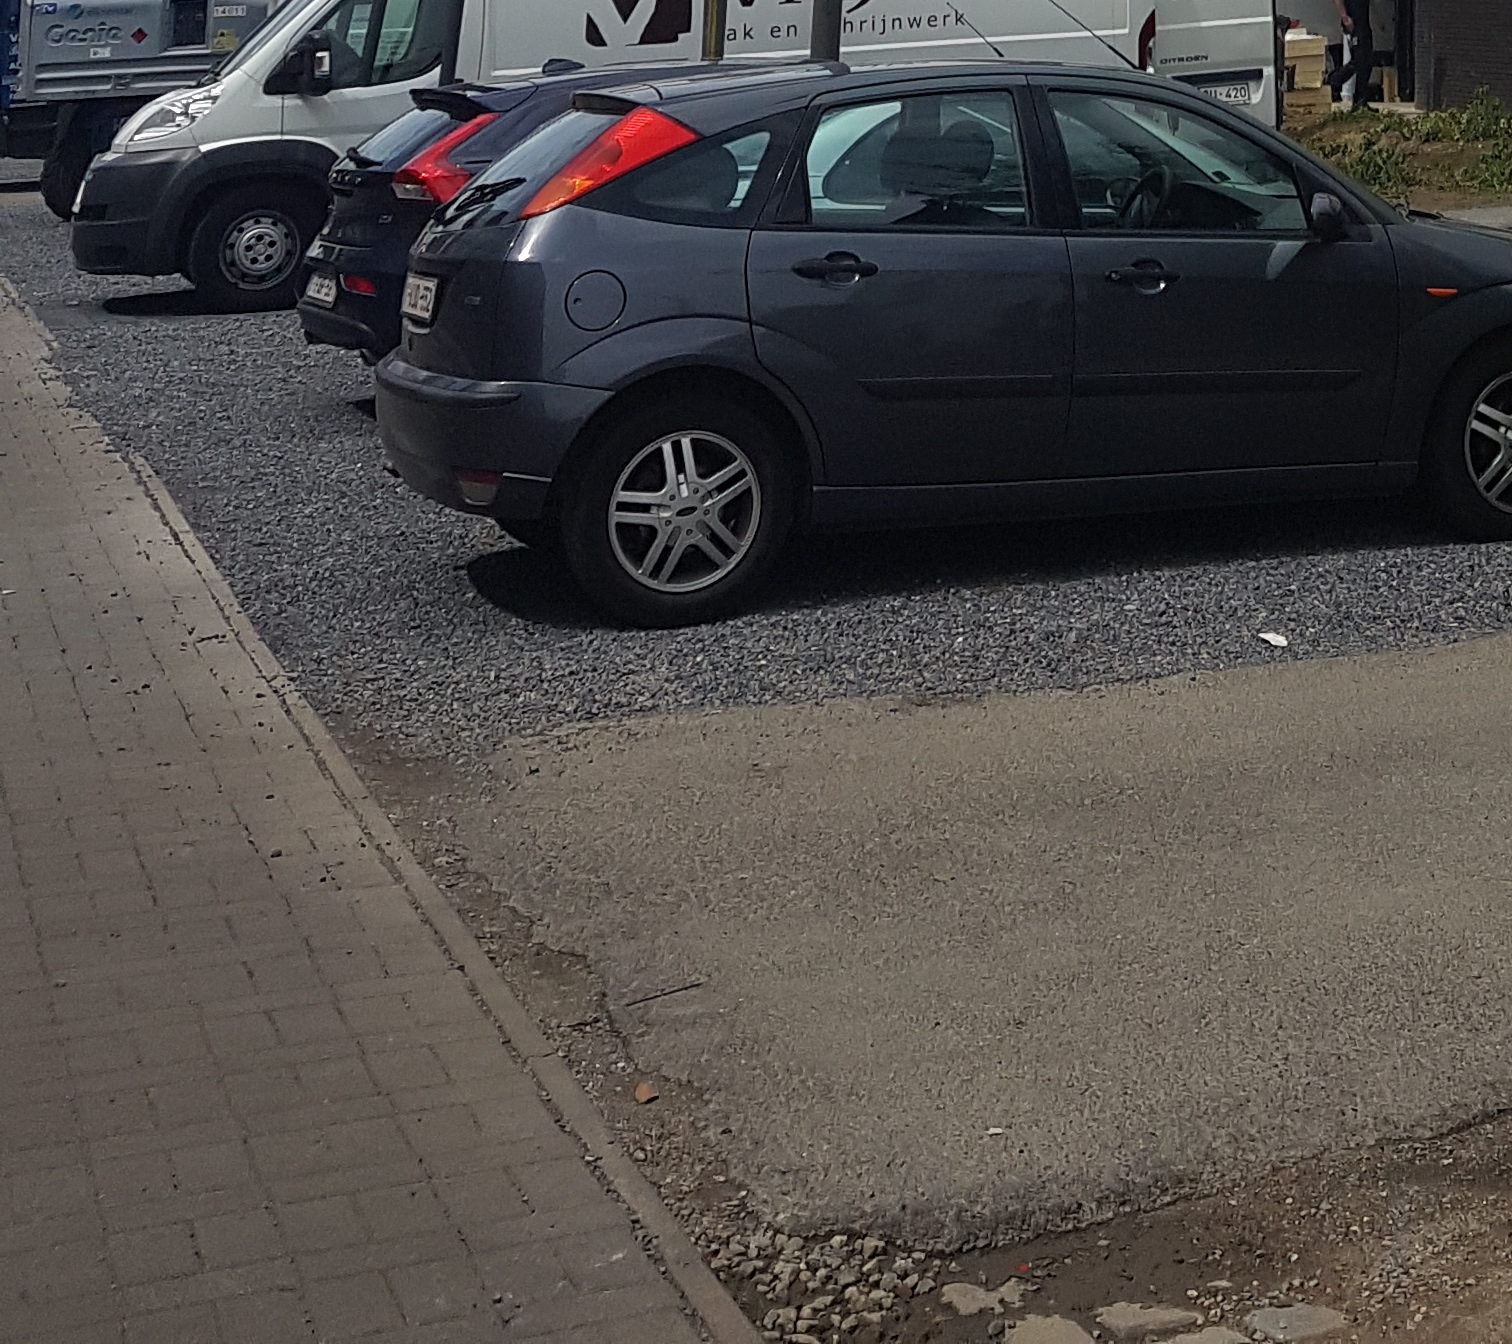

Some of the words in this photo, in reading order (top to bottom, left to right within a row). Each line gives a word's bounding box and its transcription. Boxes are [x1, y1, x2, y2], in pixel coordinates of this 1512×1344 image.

[726, 23, 755, 42] ak
[770, 23, 798, 39] en
[842, 9, 966, 36] hrijnwerk
